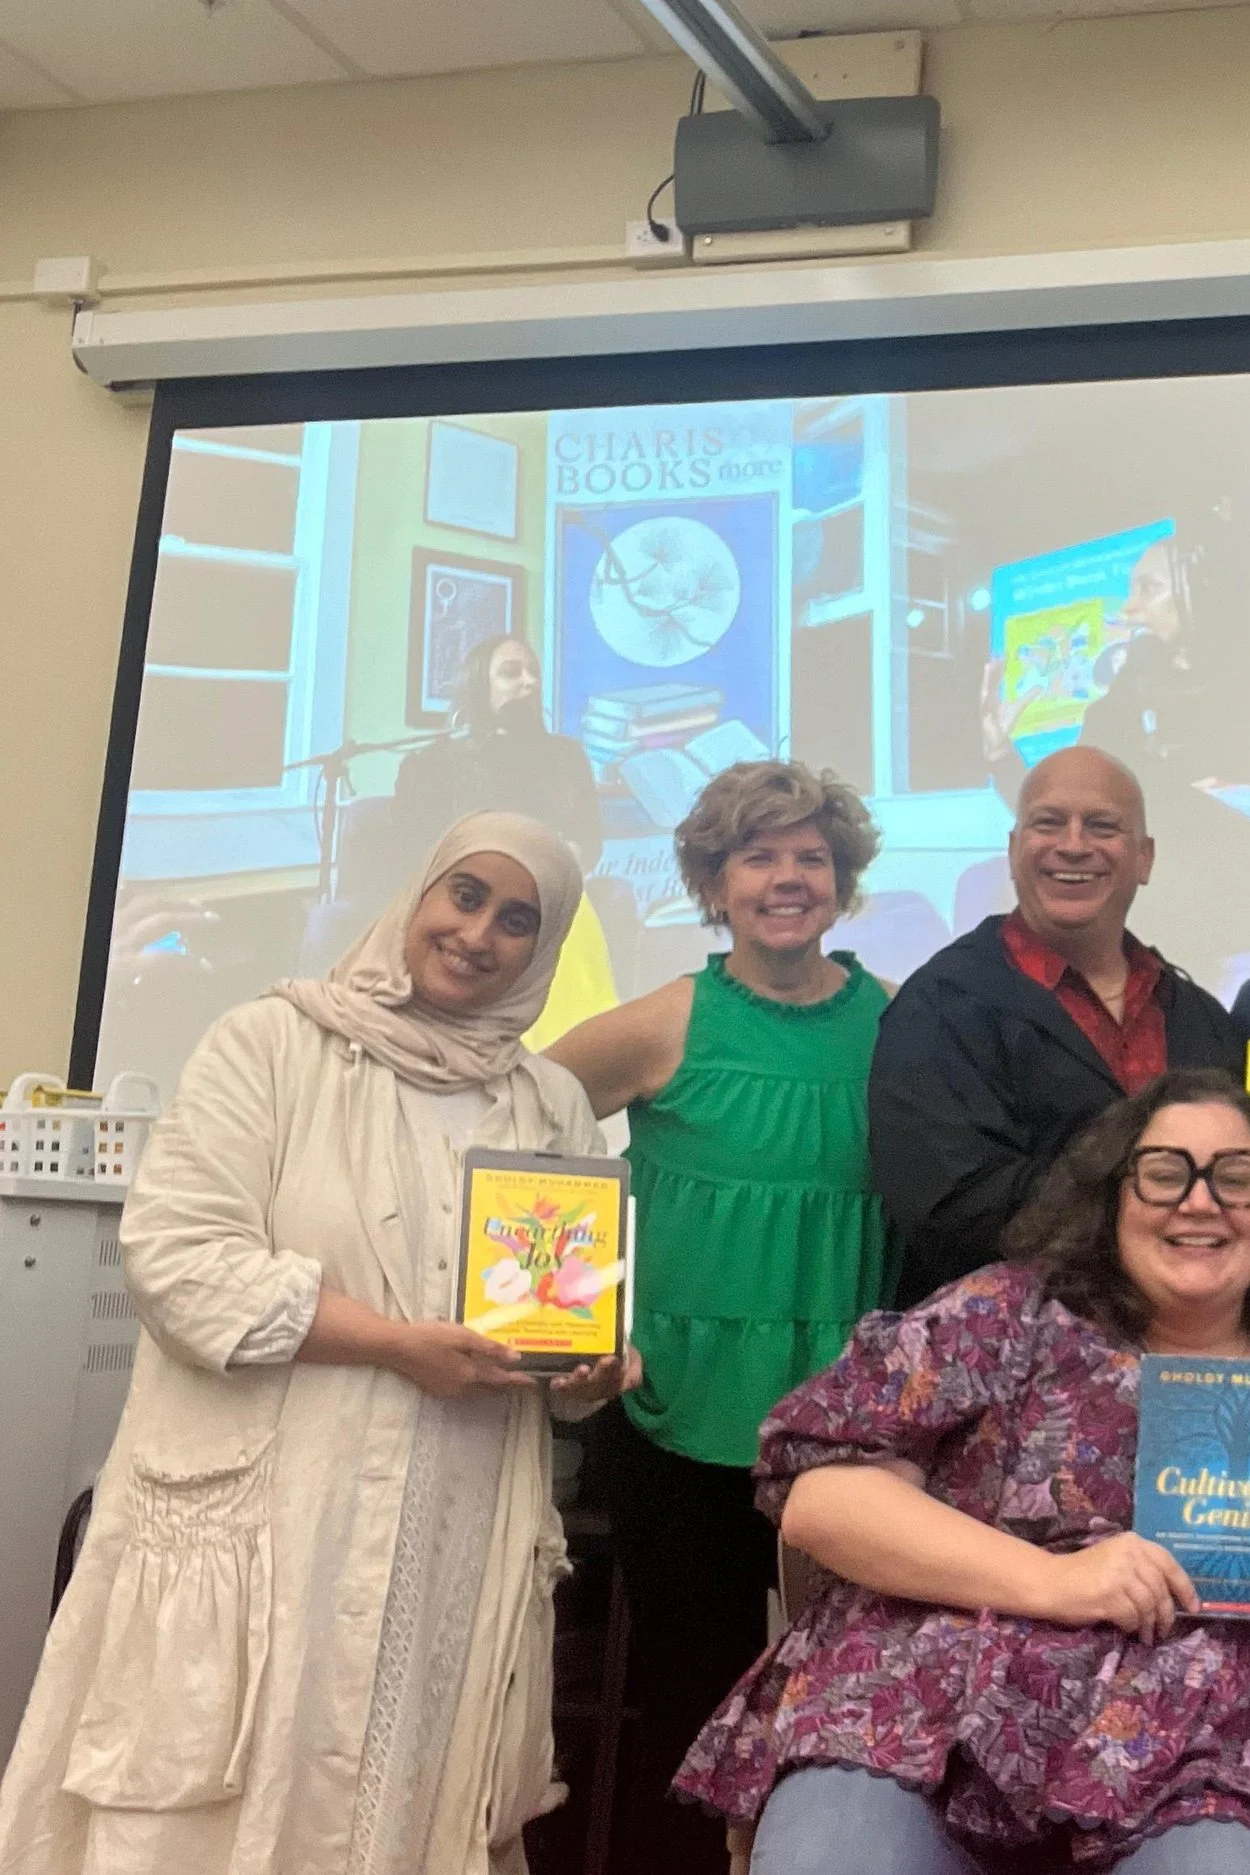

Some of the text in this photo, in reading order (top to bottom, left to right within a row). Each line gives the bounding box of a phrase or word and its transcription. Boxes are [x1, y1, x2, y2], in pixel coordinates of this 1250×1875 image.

[555, 426, 725, 463] CHARIS
[556, 459, 711, 495] BOOKS
[1160, 1370, 1225, 1385] GHOLDY
